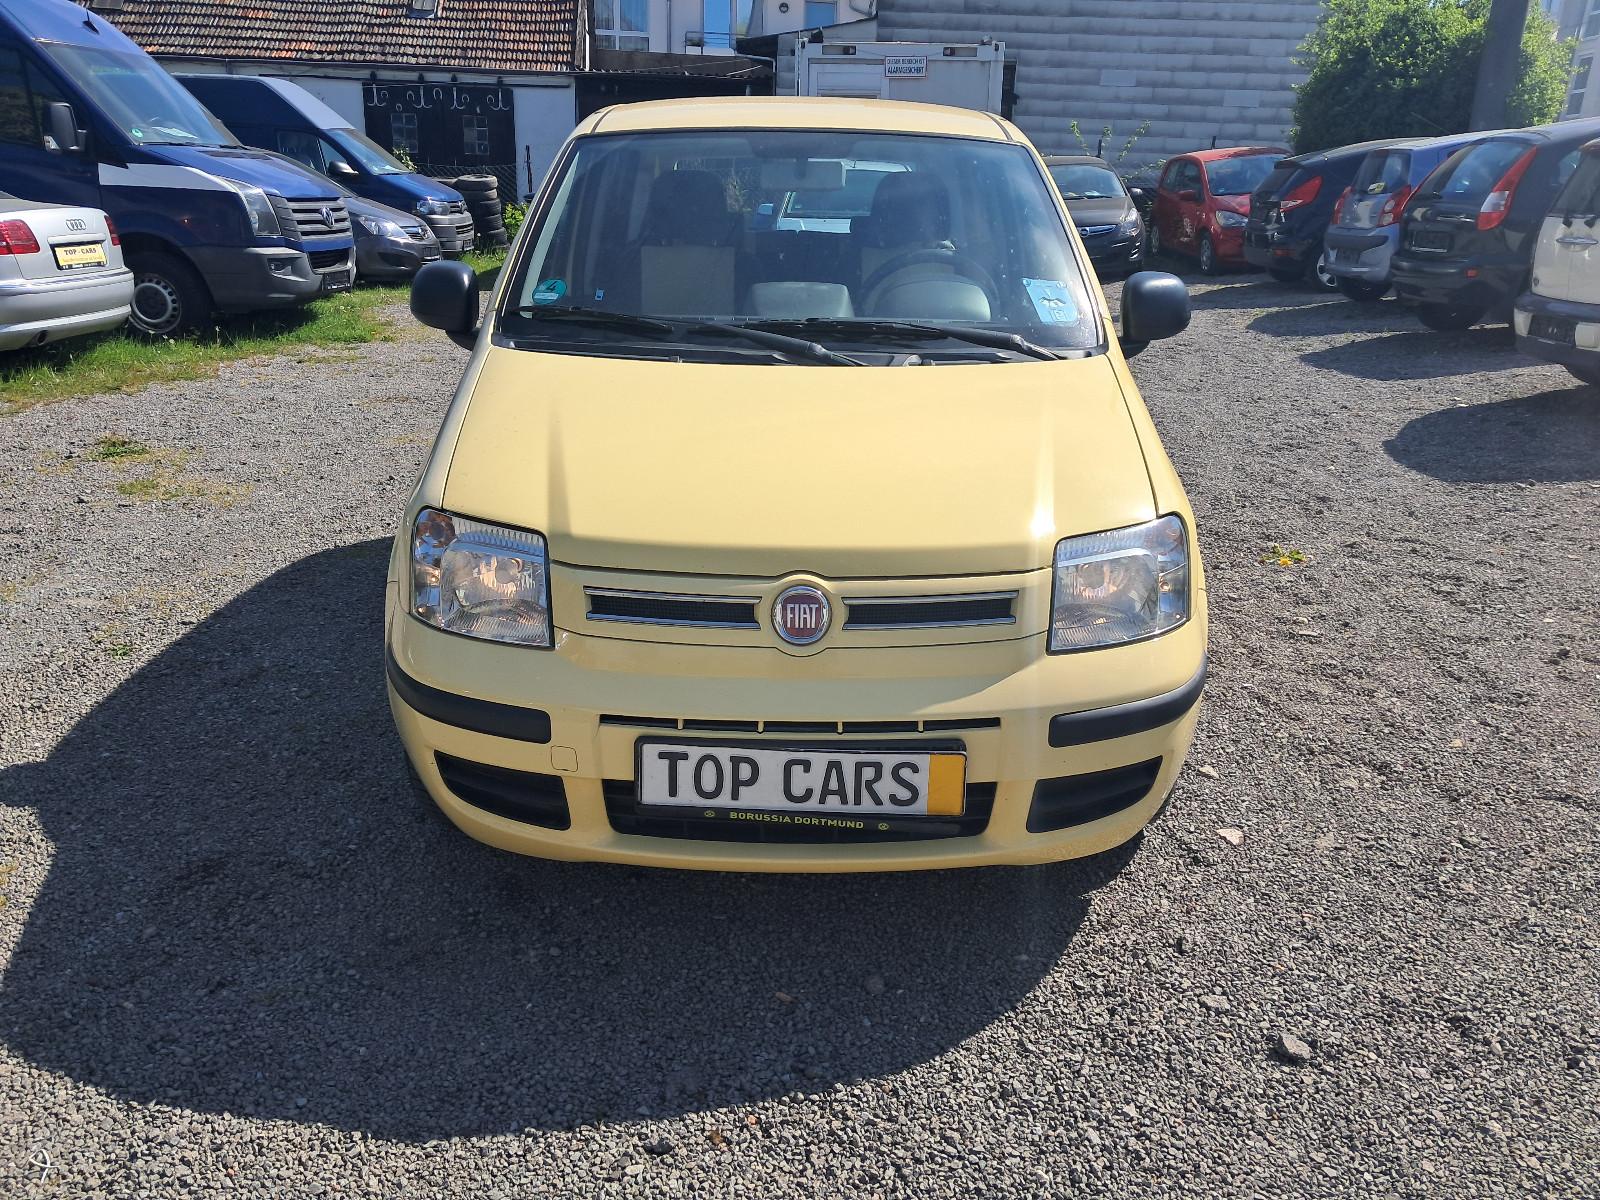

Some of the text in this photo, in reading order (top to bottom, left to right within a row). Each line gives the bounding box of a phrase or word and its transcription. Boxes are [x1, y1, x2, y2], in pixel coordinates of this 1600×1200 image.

[546, 281, 557, 292] 4
[786, 603, 819, 629] FIAT
[658, 752, 920, 806] TOP CARS
[729, 811, 864, 829] BORUSSIA DORTMUND
